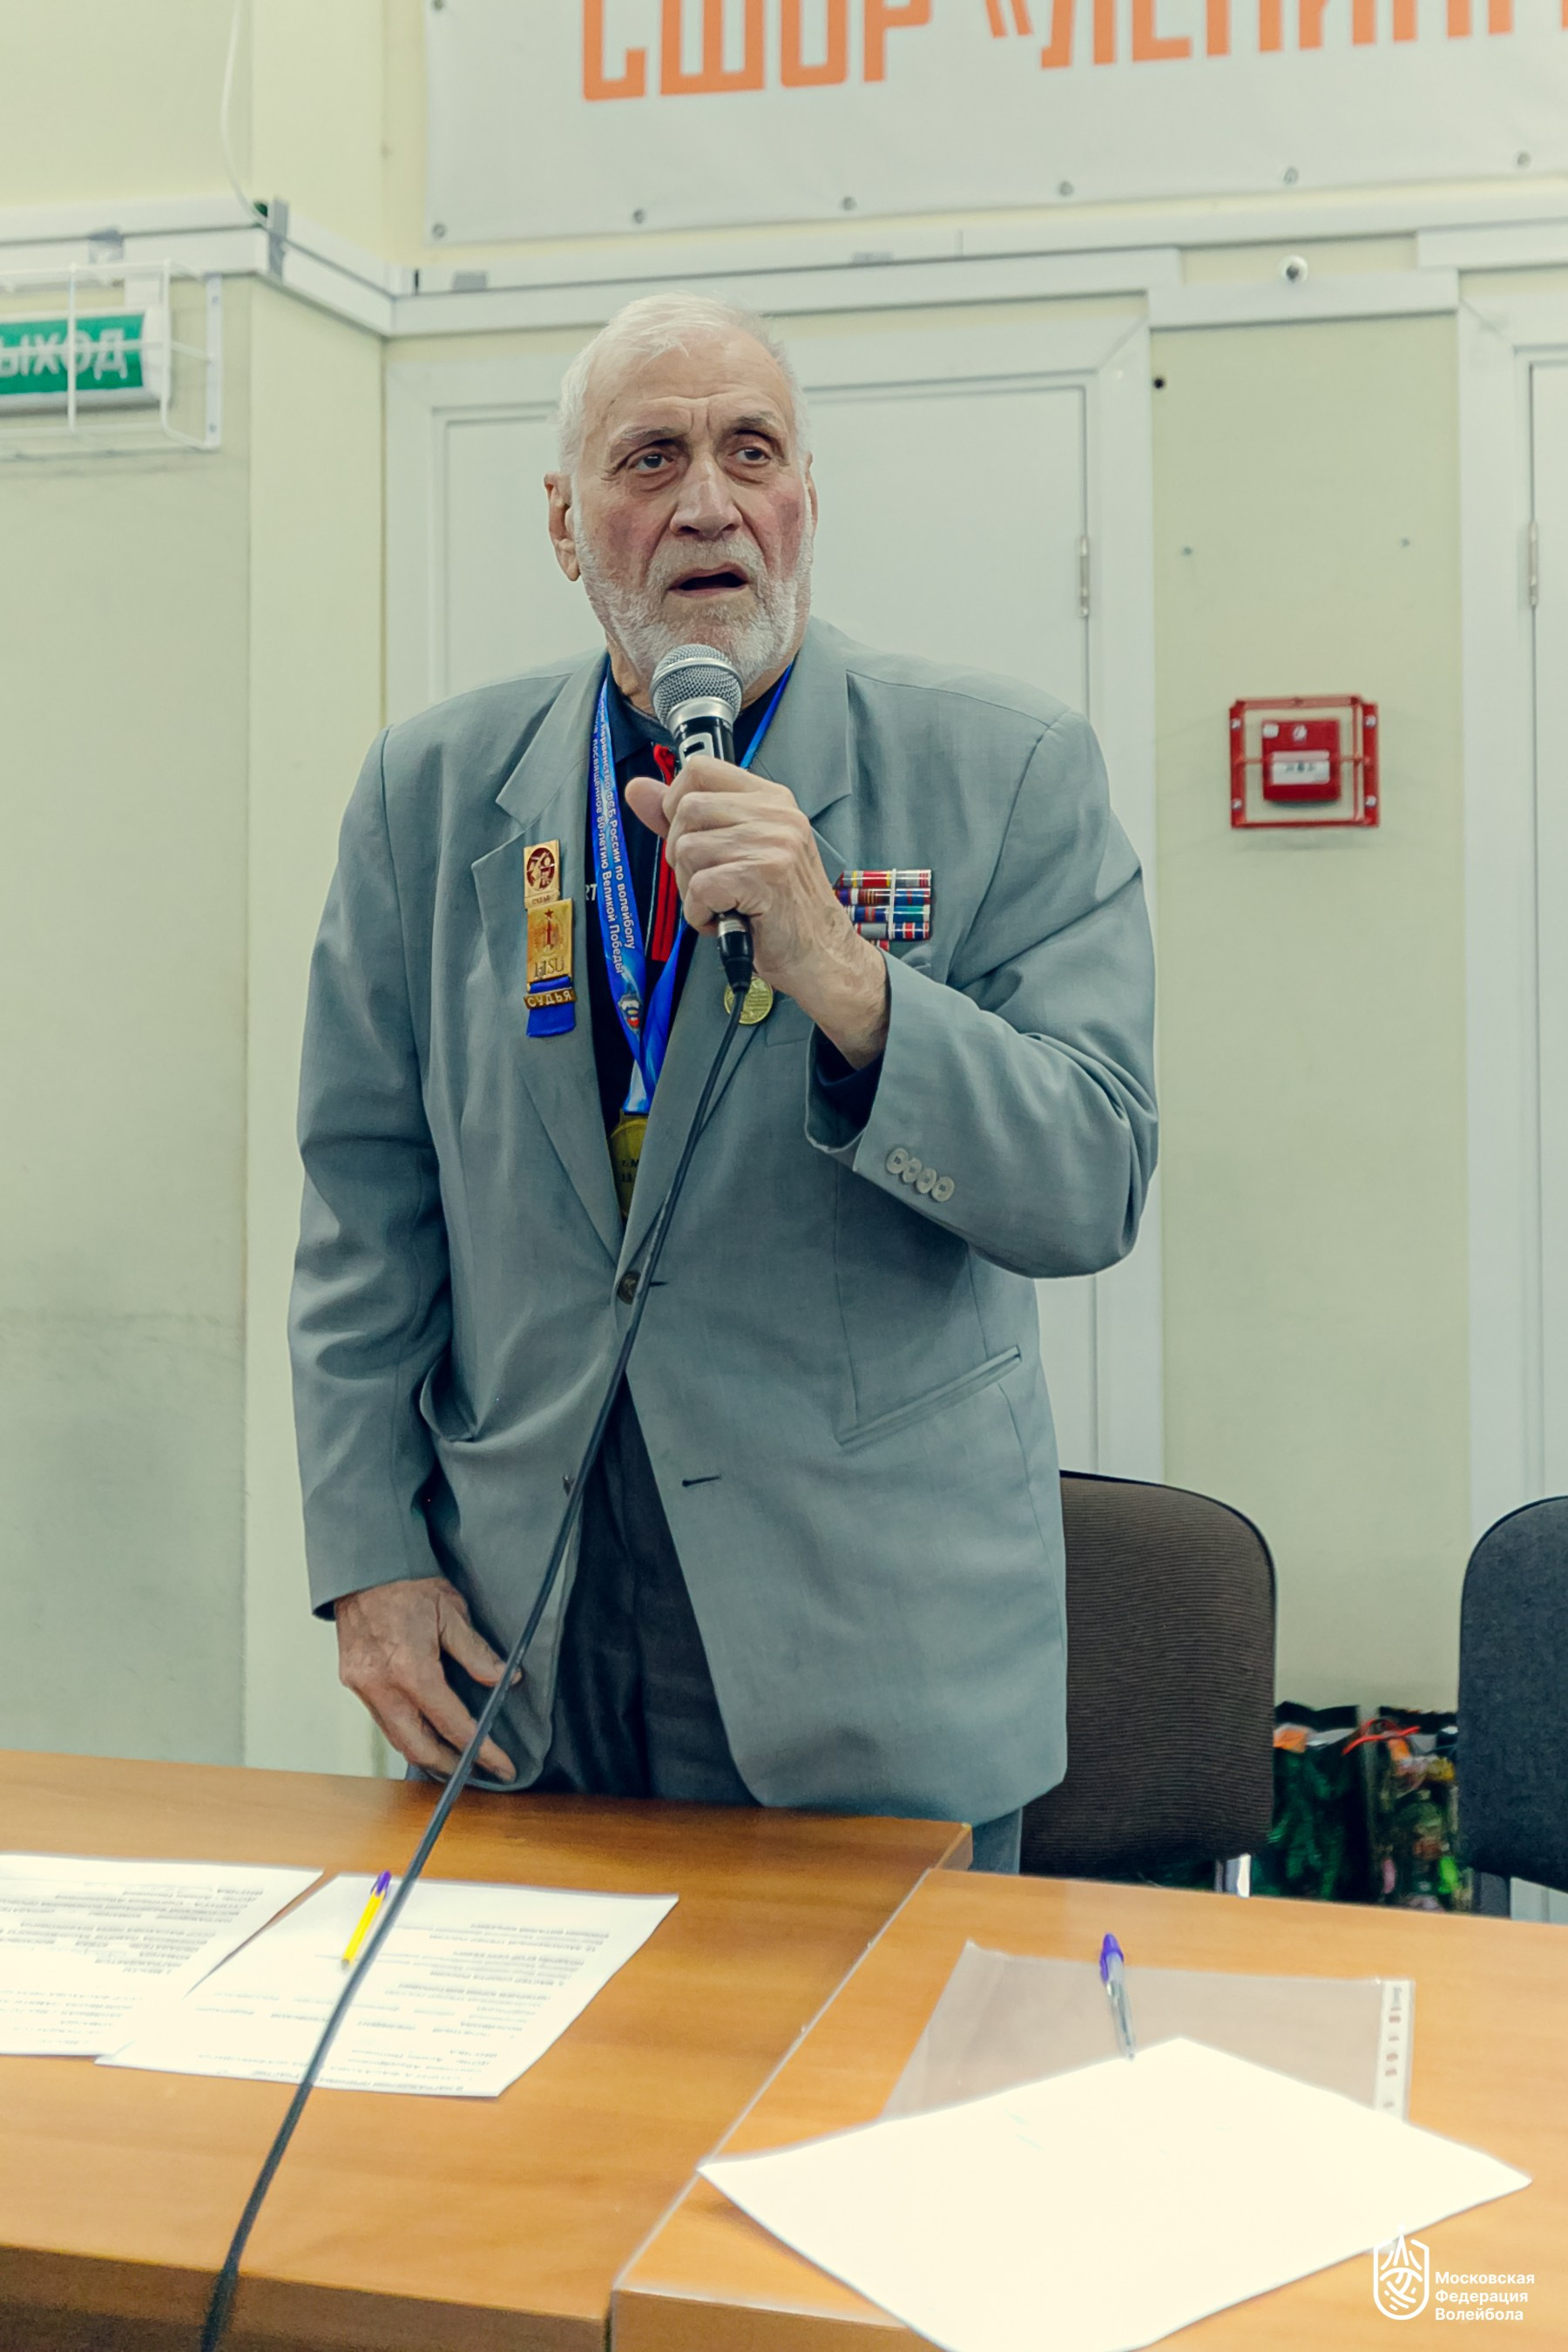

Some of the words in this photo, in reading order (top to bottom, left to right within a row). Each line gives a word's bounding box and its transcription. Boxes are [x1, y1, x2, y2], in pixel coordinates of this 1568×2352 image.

[605, 789, 617, 818] ФСБ
[597, 815, 609, 869] 80-летию
[610, 819, 621, 863] России
[602, 870, 618, 922] Великой
[615, 865, 625, 881] по
[617, 883, 636, 950] волейболу
[609, 924, 624, 974] Победы
[527, 990, 572, 1007] СУДЬЯ
